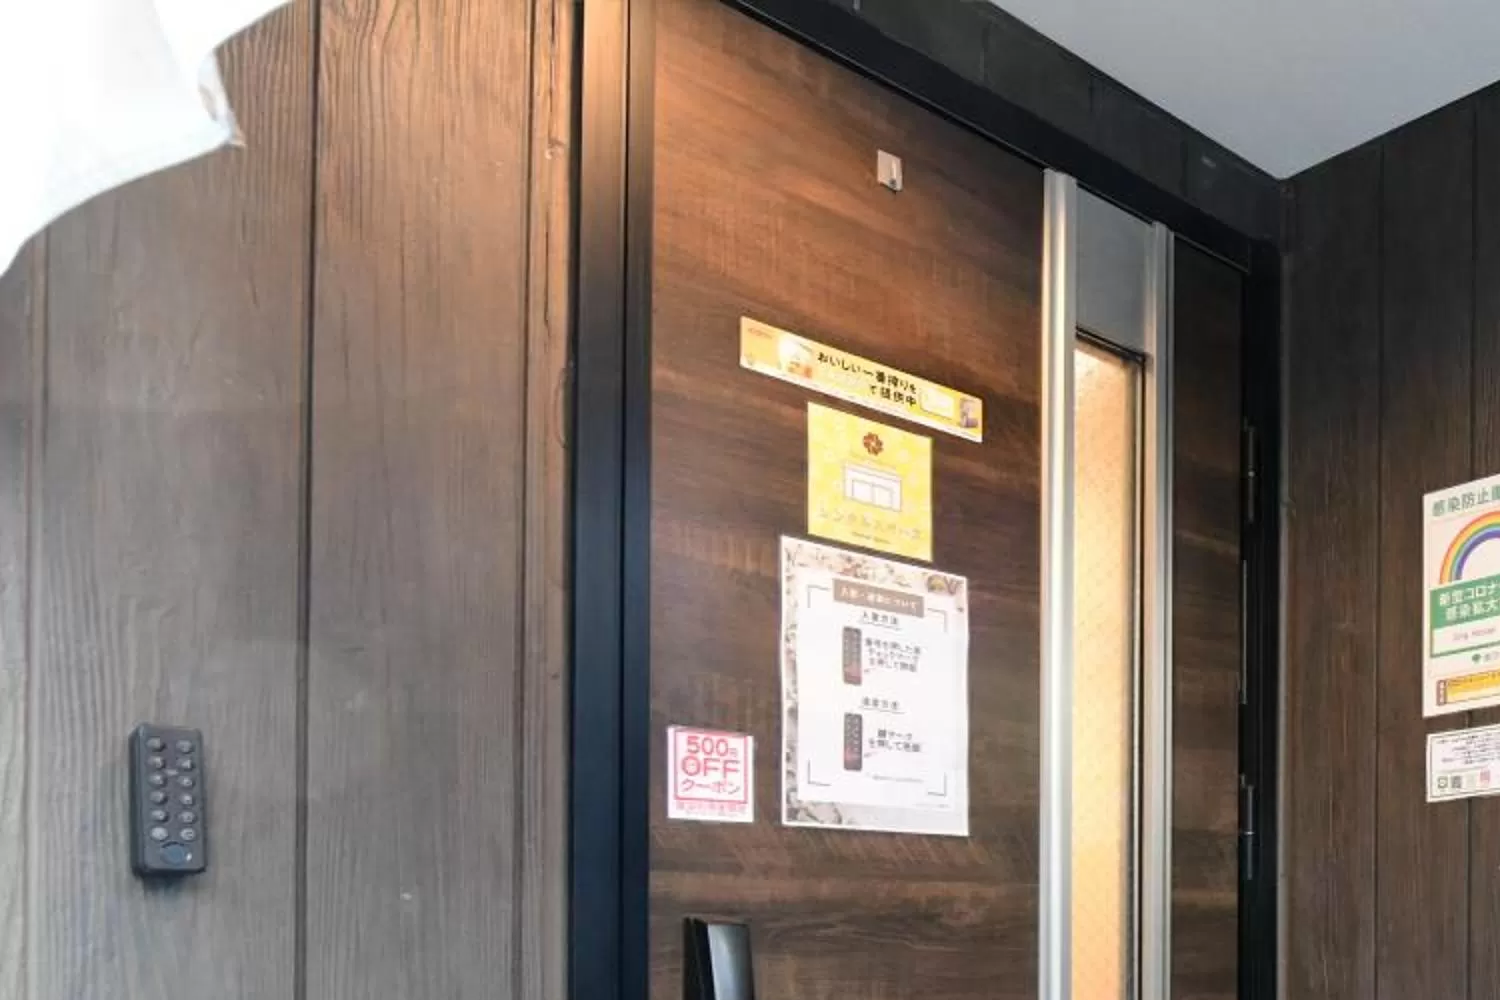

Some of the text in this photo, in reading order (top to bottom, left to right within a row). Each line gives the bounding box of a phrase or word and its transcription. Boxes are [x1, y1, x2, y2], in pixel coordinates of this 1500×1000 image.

[682, 756, 741, 778] OFF
[681, 778, 741, 795] クーポン
